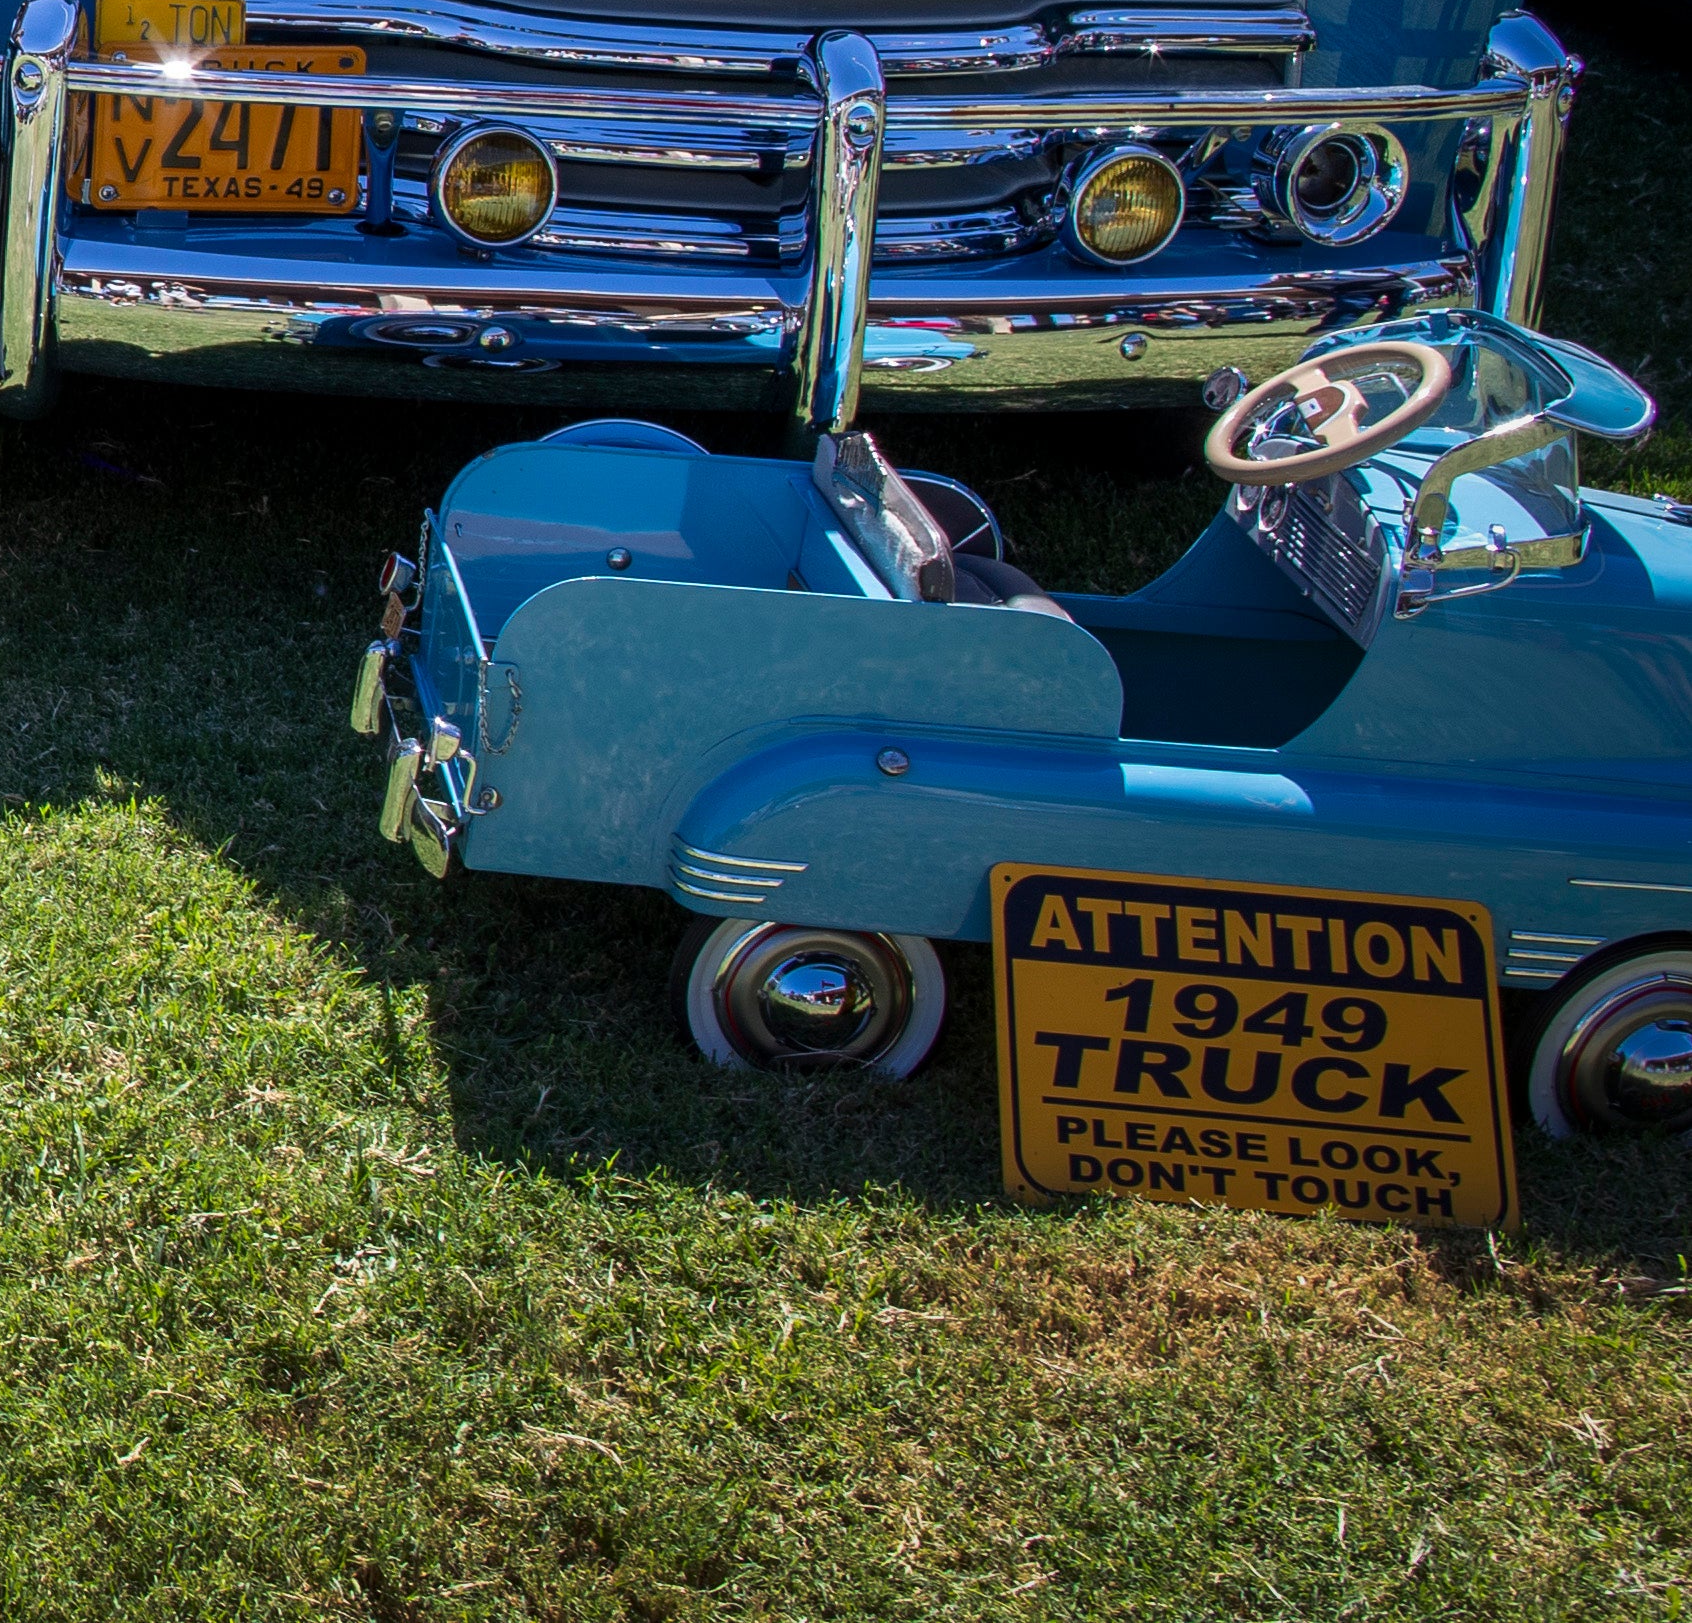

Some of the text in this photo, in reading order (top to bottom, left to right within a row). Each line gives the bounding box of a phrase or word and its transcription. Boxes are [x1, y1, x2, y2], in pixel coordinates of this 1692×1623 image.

[168, 3, 232, 45] TON
[1030, 893, 1464, 985] ATTENTION
[1104, 977, 1389, 1053] 1949
[1034, 1031, 1471, 1125] TRUCK
[1056, 1115, 1462, 1187] PLEASE LOOK,
[1068, 1152, 1455, 1218] DON'T TOUCH
